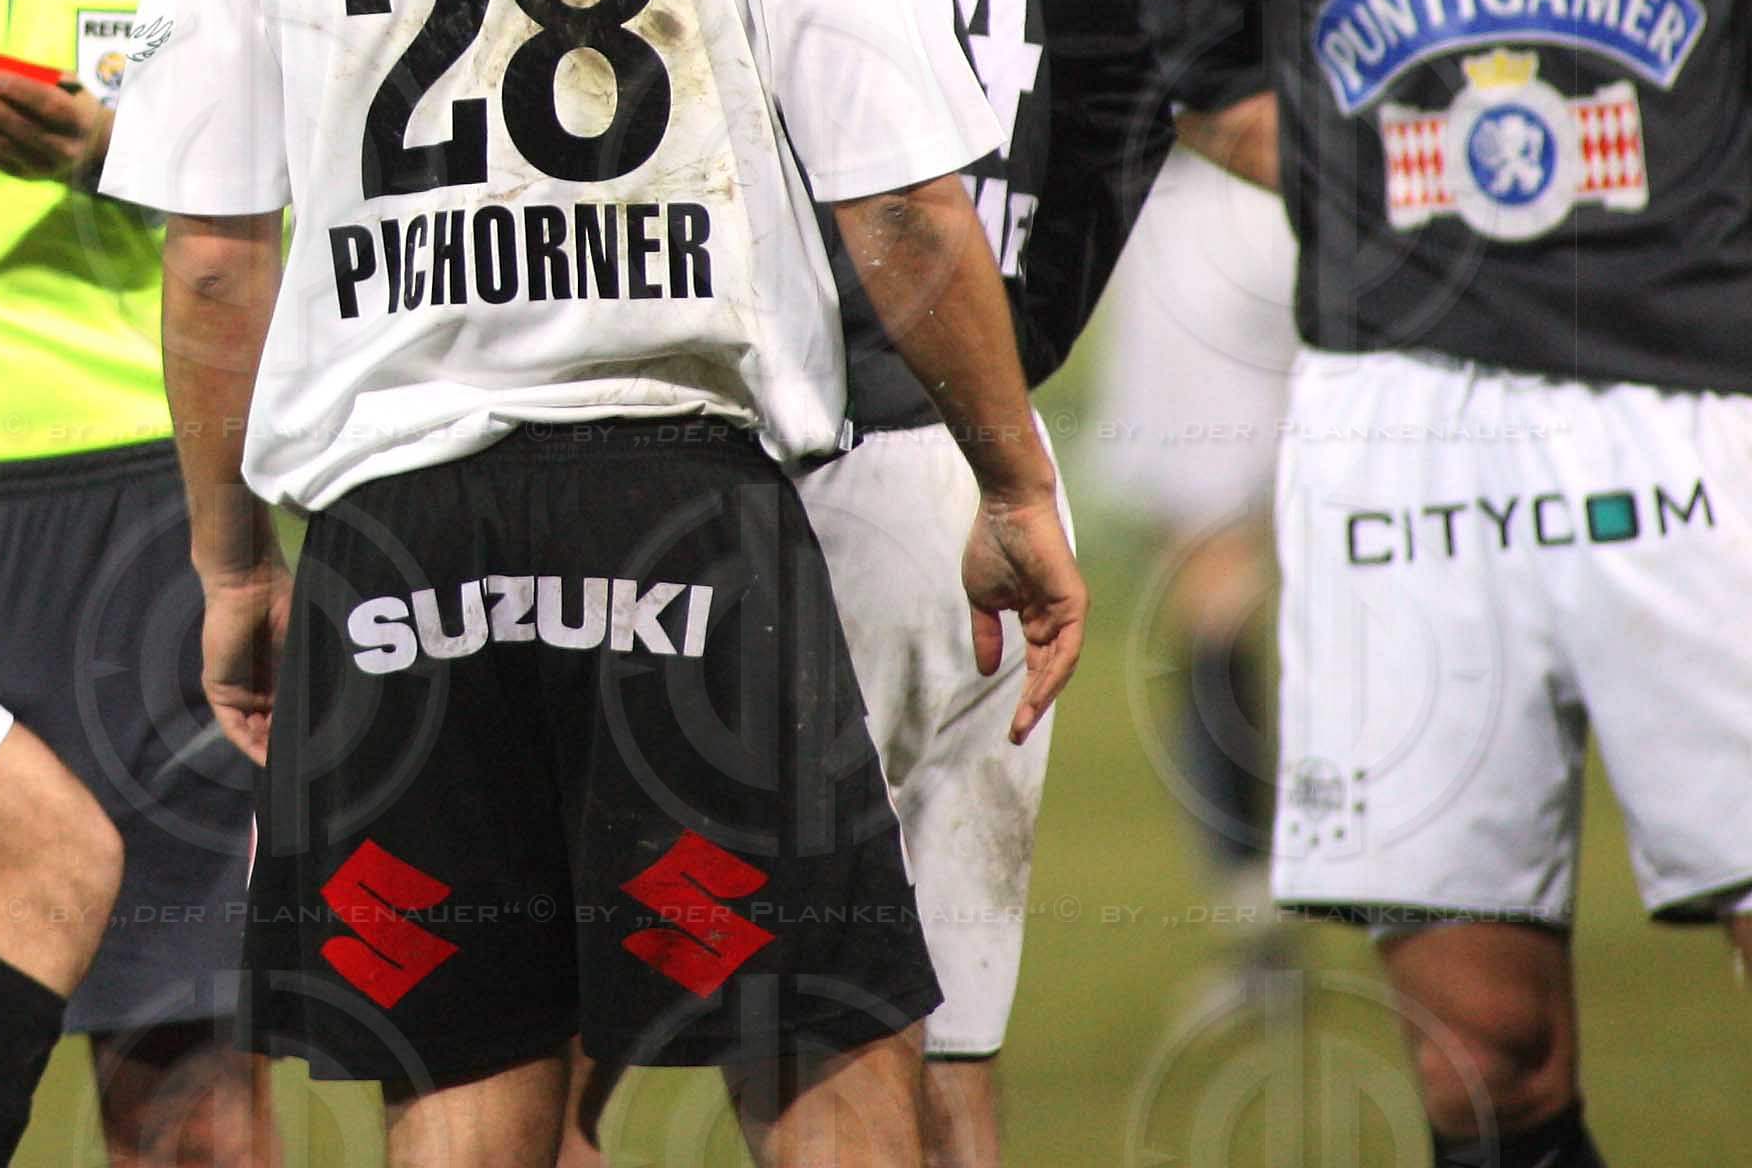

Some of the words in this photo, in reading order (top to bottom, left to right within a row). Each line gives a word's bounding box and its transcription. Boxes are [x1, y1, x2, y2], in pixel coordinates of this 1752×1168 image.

[329, 203, 714, 319] PICHORNER
[1346, 478, 1714, 566] CITYCOM
[348, 575, 714, 674] SUZUKI
